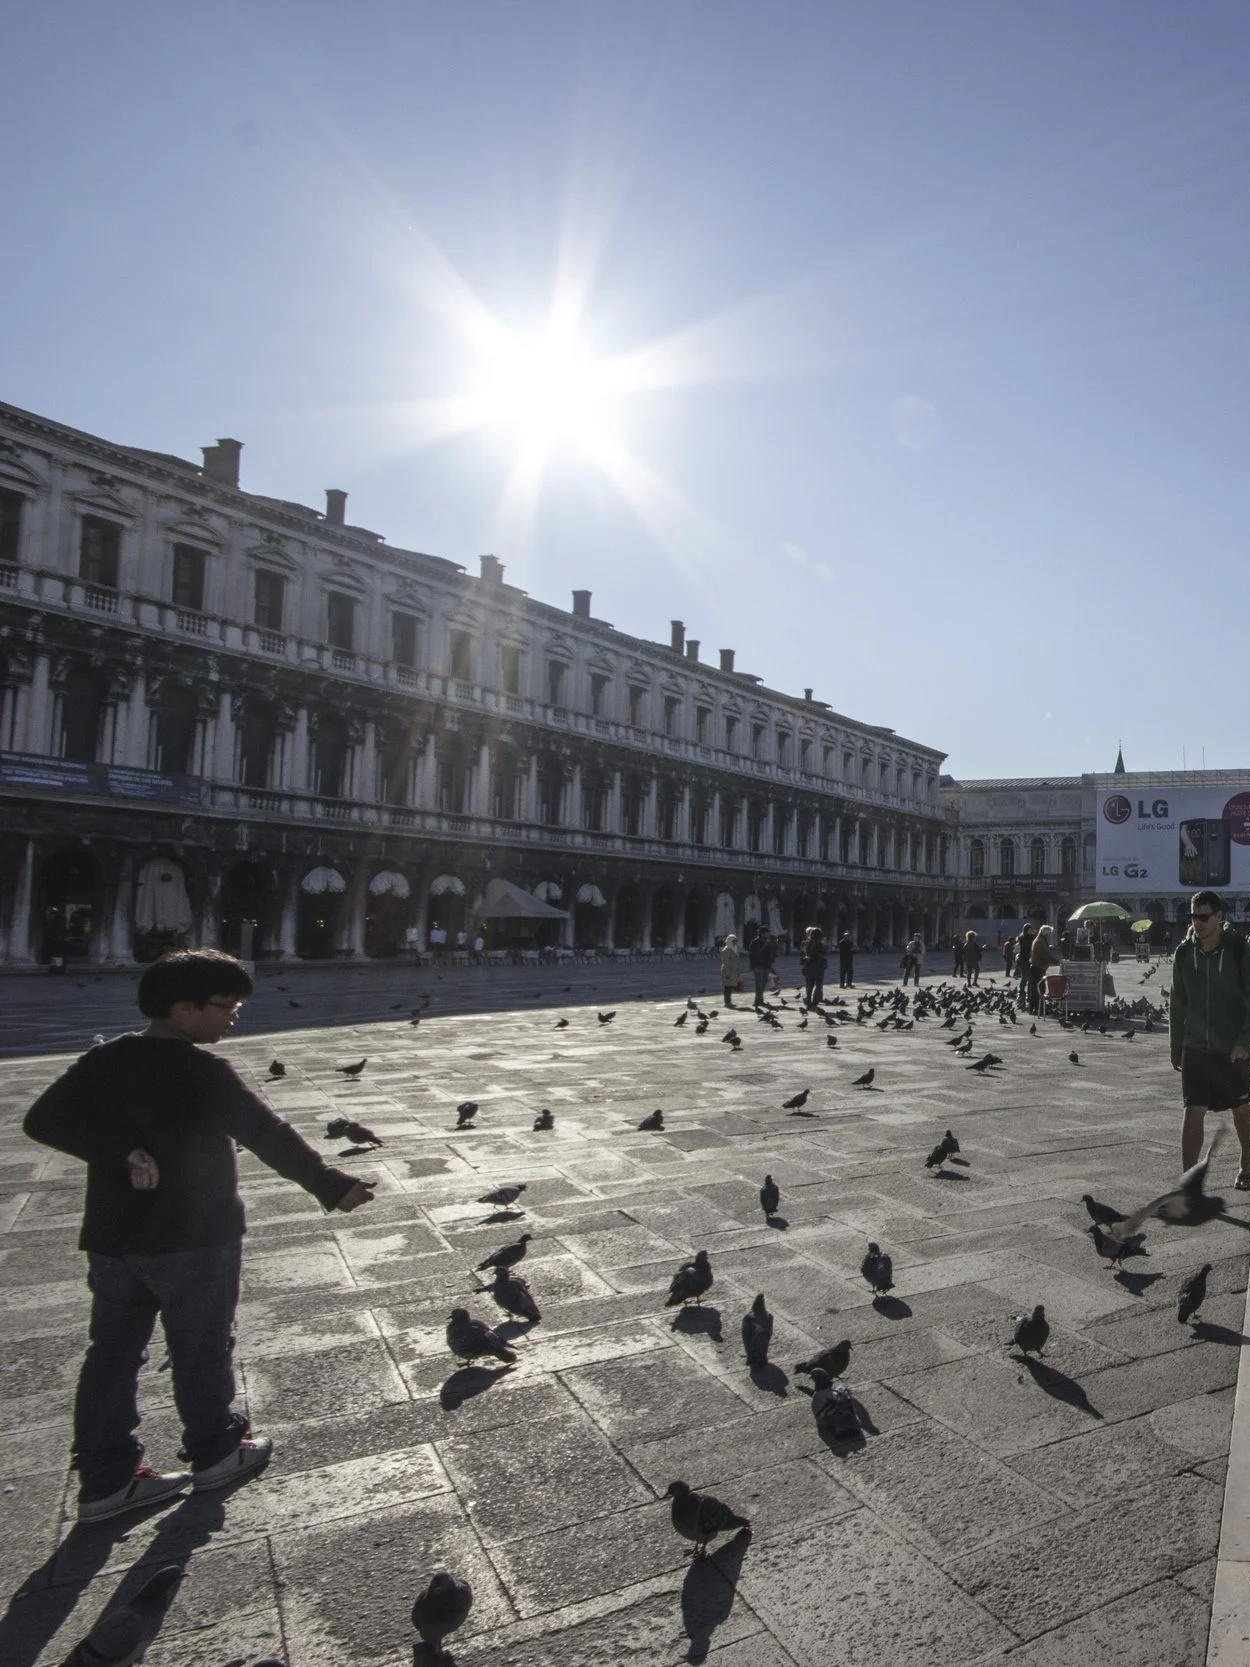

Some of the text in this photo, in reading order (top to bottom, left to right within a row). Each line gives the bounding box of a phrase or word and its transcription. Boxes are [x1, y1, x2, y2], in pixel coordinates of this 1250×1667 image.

[1138, 800, 1169, 818] LG
[1138, 823, 1175, 831] Life's Good
[1102, 864, 1148, 878] LG G2
